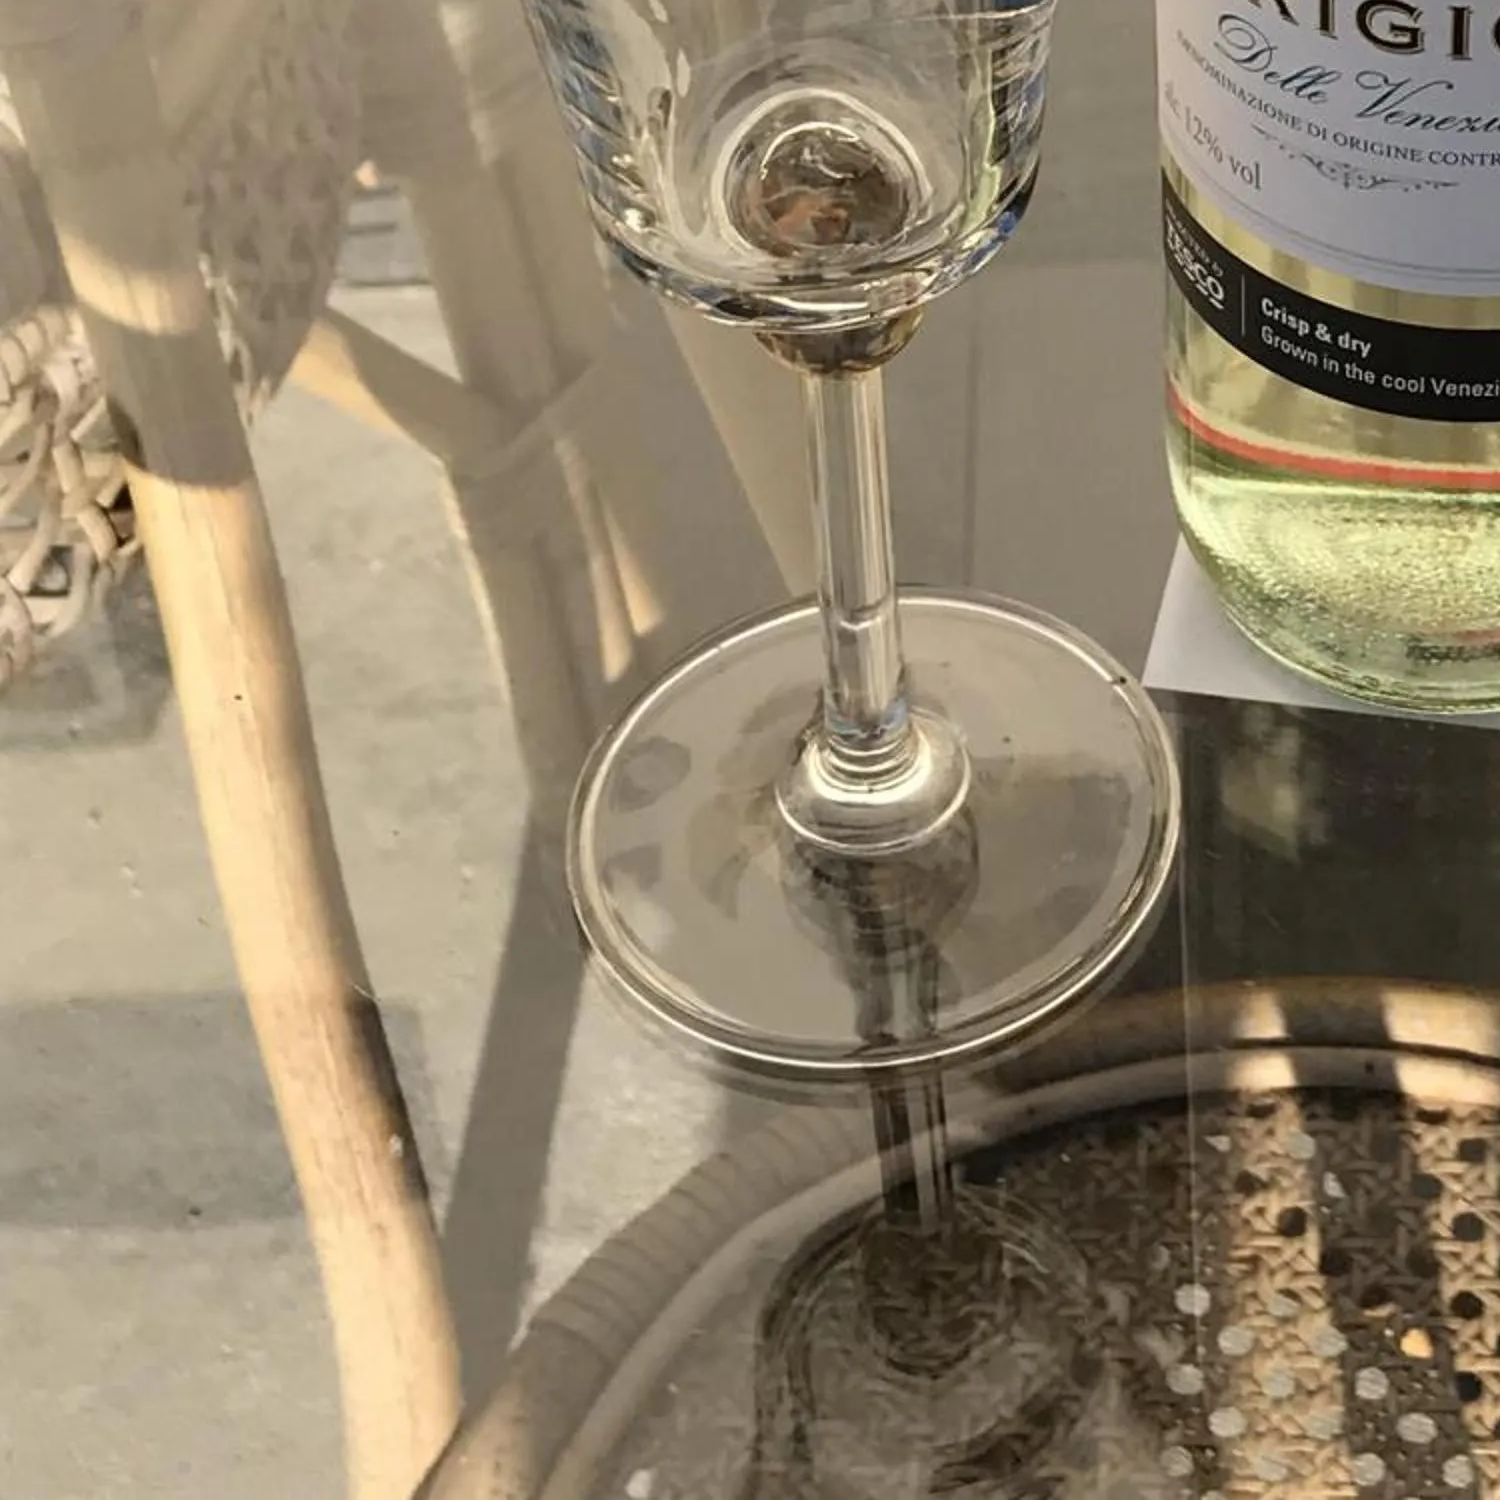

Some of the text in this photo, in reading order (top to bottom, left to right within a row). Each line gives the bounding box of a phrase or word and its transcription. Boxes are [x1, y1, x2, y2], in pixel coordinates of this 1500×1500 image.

[1213, 13, 1342, 105] Delle
[1306, 121, 1328, 141] DI
[1332, 131, 1424, 163] ORIGINE
[1229, 155, 1263, 191] vol
[1261, 298, 1372, 359] Crisp & dry
[1261, 325, 1319, 367] Grown
[1323, 354, 1340, 374] in
[1345, 362, 1376, 386] the
[1381, 374, 1426, 393] cool
